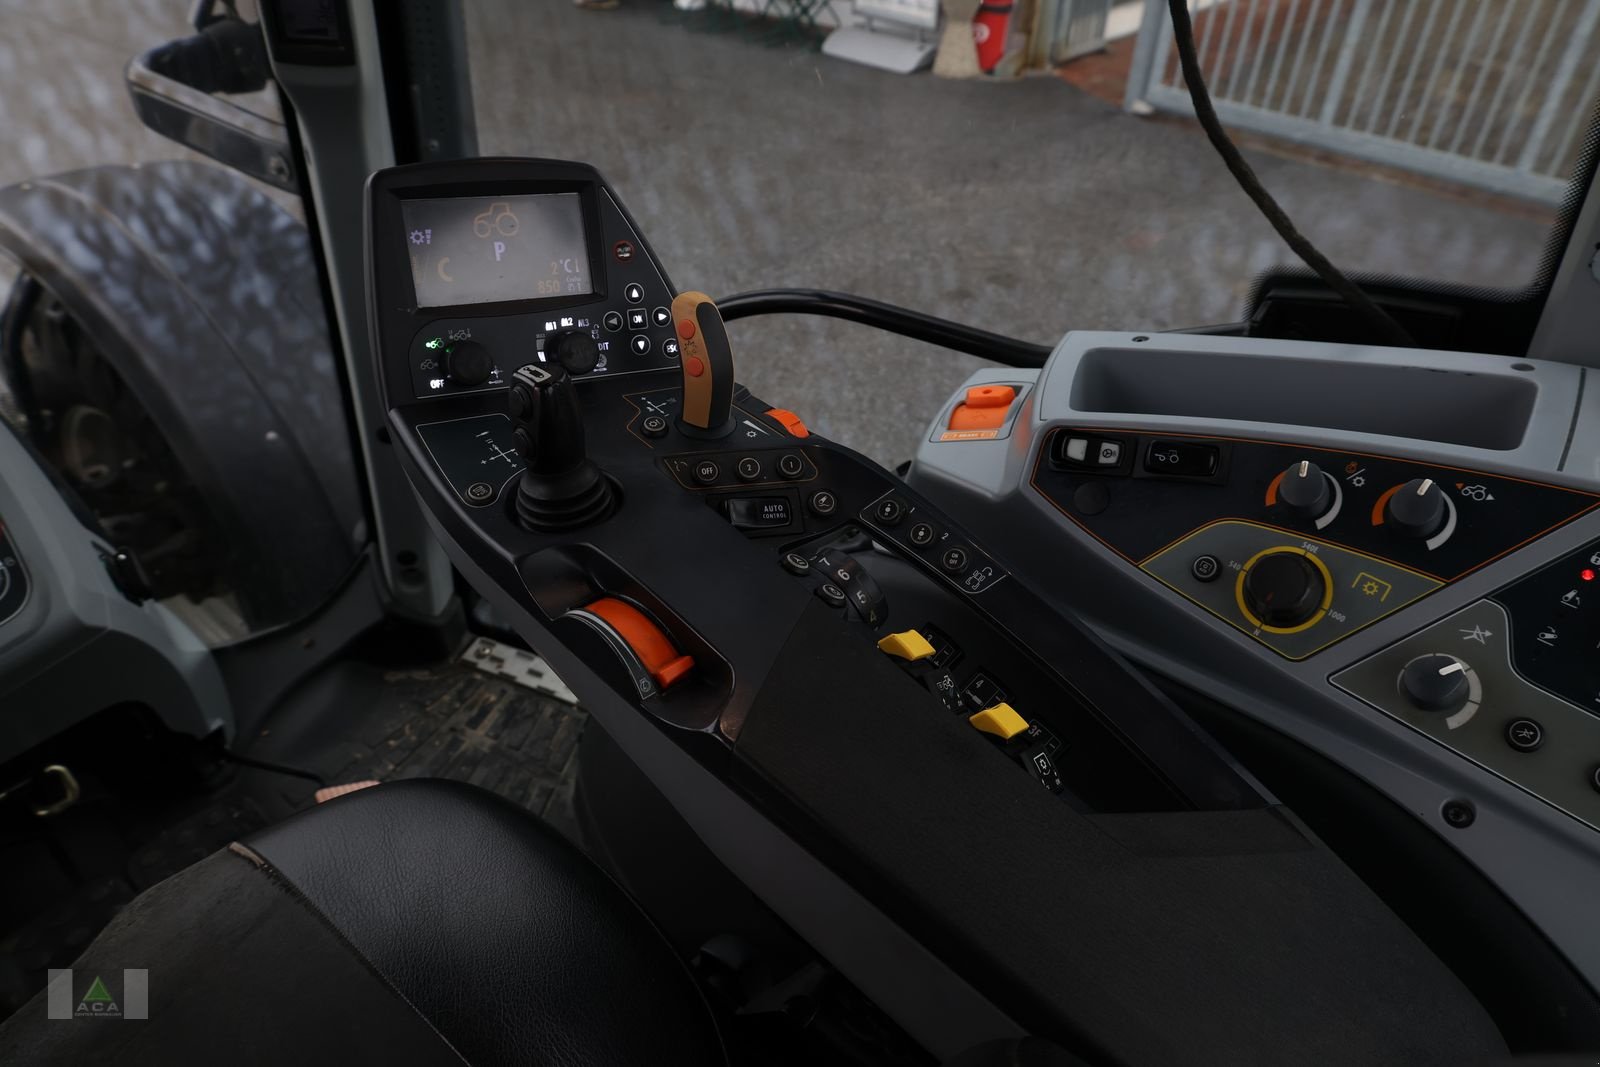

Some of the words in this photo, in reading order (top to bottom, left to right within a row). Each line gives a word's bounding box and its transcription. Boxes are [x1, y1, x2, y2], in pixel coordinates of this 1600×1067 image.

[493, 241, 506, 262] P
[537, 280, 560, 295] 850
[561, 317, 573, 327] M2
[578, 318, 589, 327] M3
[633, 315, 643, 324] OK
[545, 321, 557, 331] M1
[597, 342, 609, 351] DIT
[430, 379, 444, 389] OFF
[701, 467, 714, 475] OFF
[764, 504, 784, 512] AUTO
[941, 532, 949, 540] 2
[818, 557, 831, 567] 7
[1228, 560, 1241, 570] 540
[837, 569, 850, 581] 6
[856, 590, 867, 604] 5
[1327, 609, 1346, 622] 1000
[976, 679, 984, 688] 4
[1028, 724, 1042, 737] 3F
